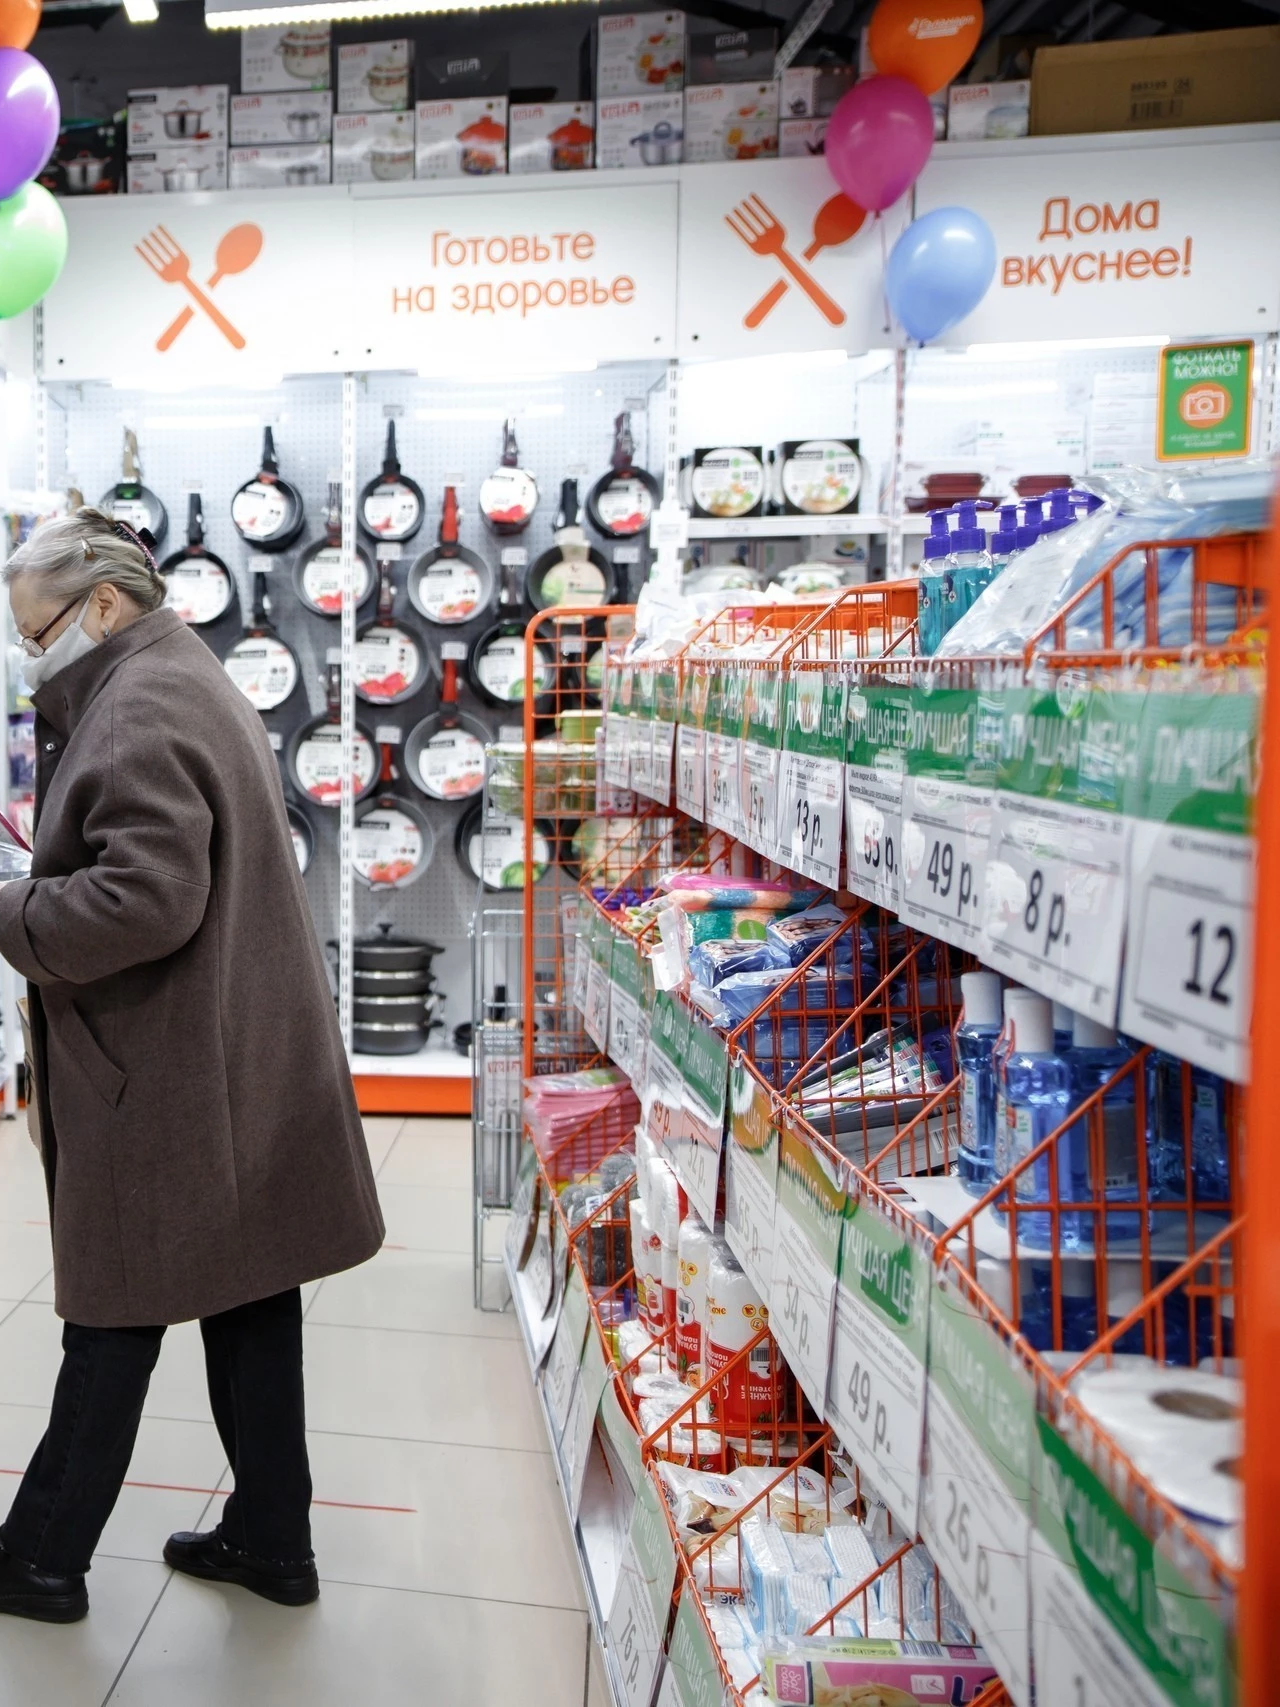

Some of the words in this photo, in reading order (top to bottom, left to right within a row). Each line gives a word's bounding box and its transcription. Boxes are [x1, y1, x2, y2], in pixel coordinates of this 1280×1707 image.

[1039, 195, 1160, 241] Дома
[431, 229, 596, 268] Готовьте
[1001, 237, 1193, 295] вкуснее!
[392, 281, 435, 313] на
[452, 273, 637, 318] здоровье
[1175, 362, 1238, 379] МОЖНО!
[1149, 725, 1252, 795] ЛУЧША
[796, 797, 810, 843] 13
[927, 840, 953, 898] 49
[958, 860, 977, 917] р.
[1024, 868, 1044, 933] 8
[1044, 893, 1071, 957] р.
[1183, 918, 1237, 1007] 12
[847, 1360, 871, 1429] 49
[872, 1398, 892, 1455] р.
[788, 1670, 802, 1696] Soft
